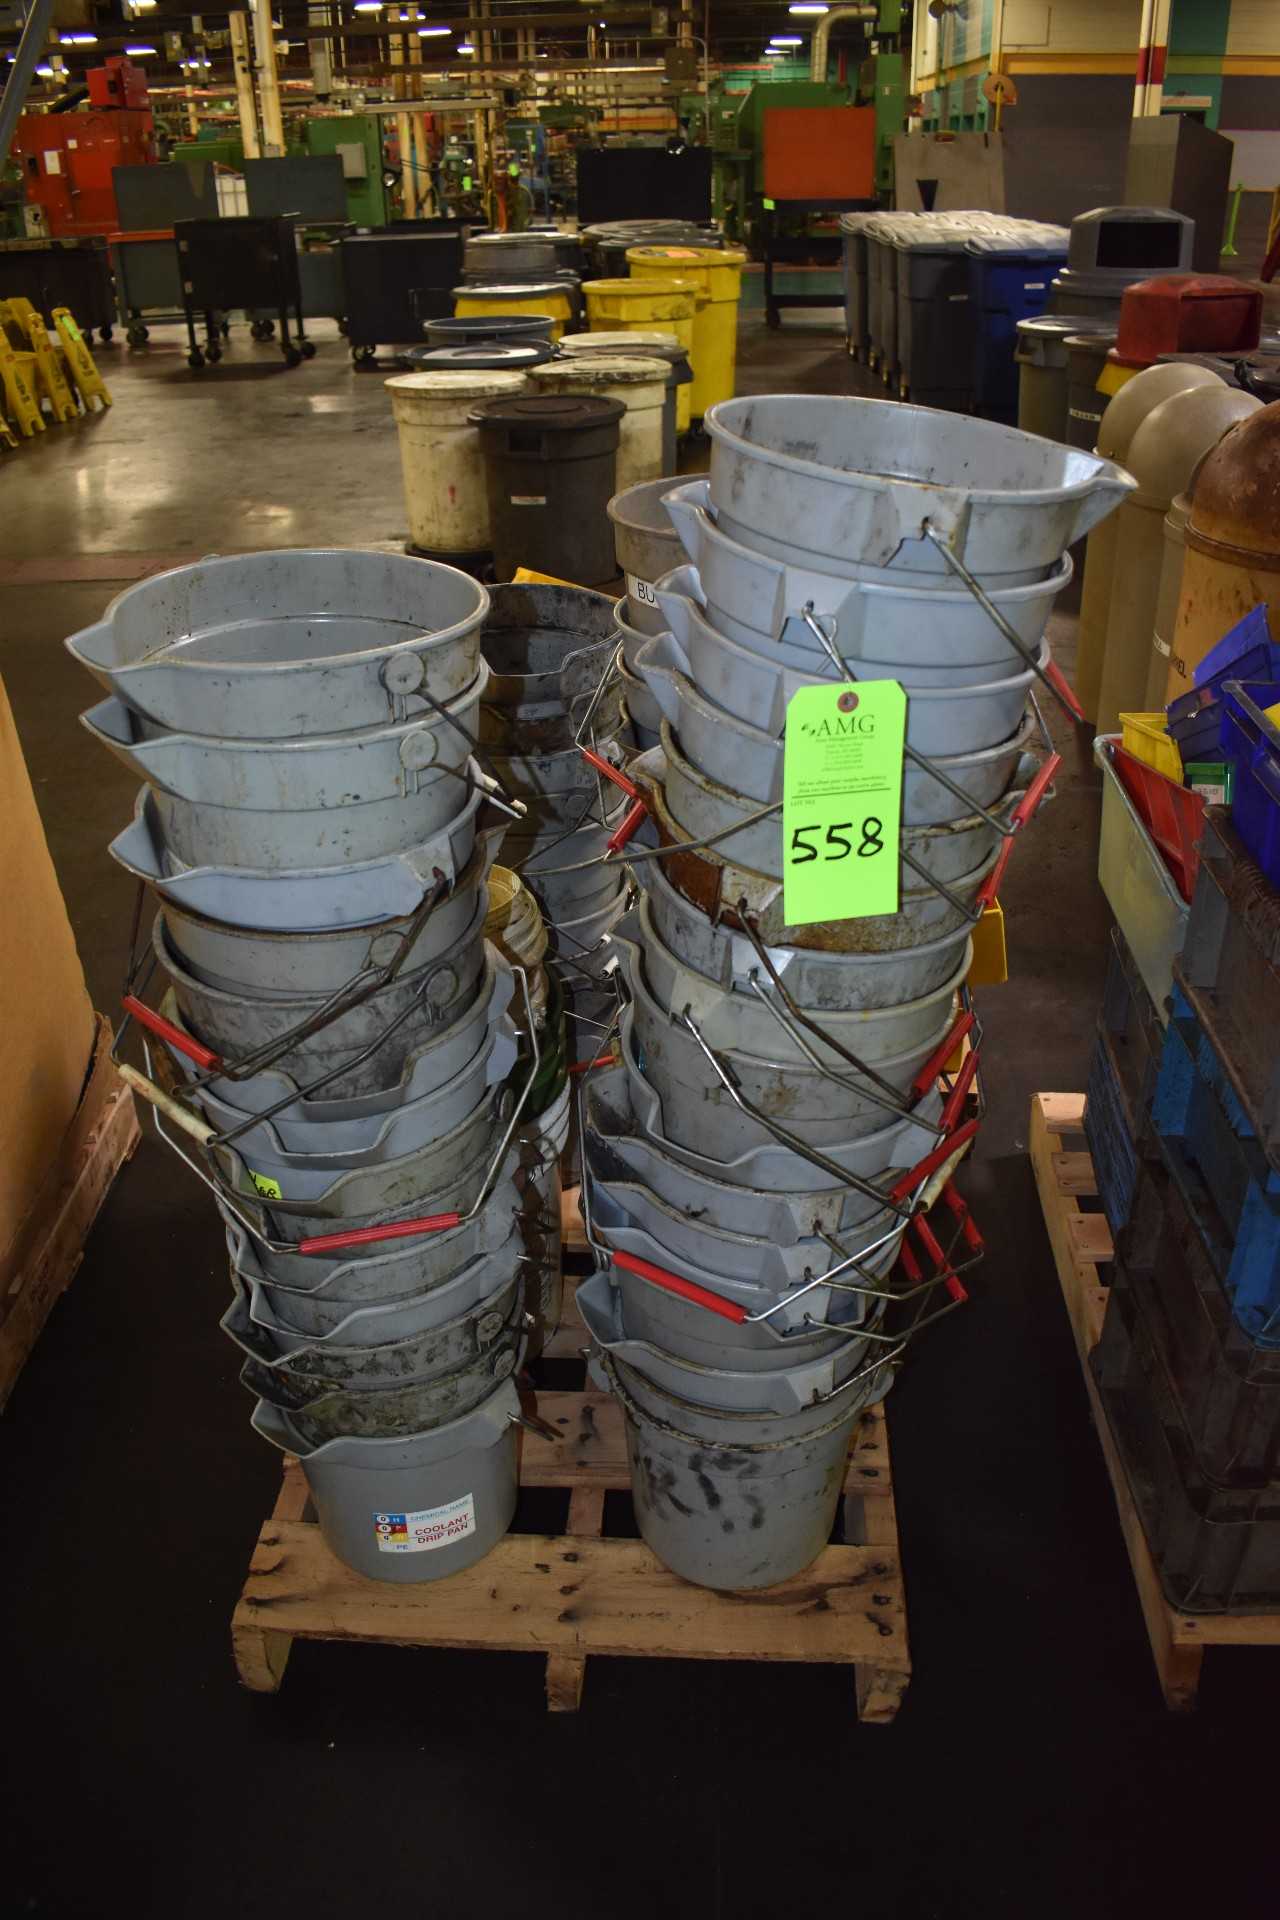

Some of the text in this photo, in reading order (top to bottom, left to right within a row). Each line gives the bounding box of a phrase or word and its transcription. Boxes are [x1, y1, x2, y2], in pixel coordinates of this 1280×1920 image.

[817, 715, 875, 737] AMG
[791, 816, 884, 864] 558
[415, 1513, 469, 1536] COOLANT
[417, 1522, 468, 1544] DRIP PAN
